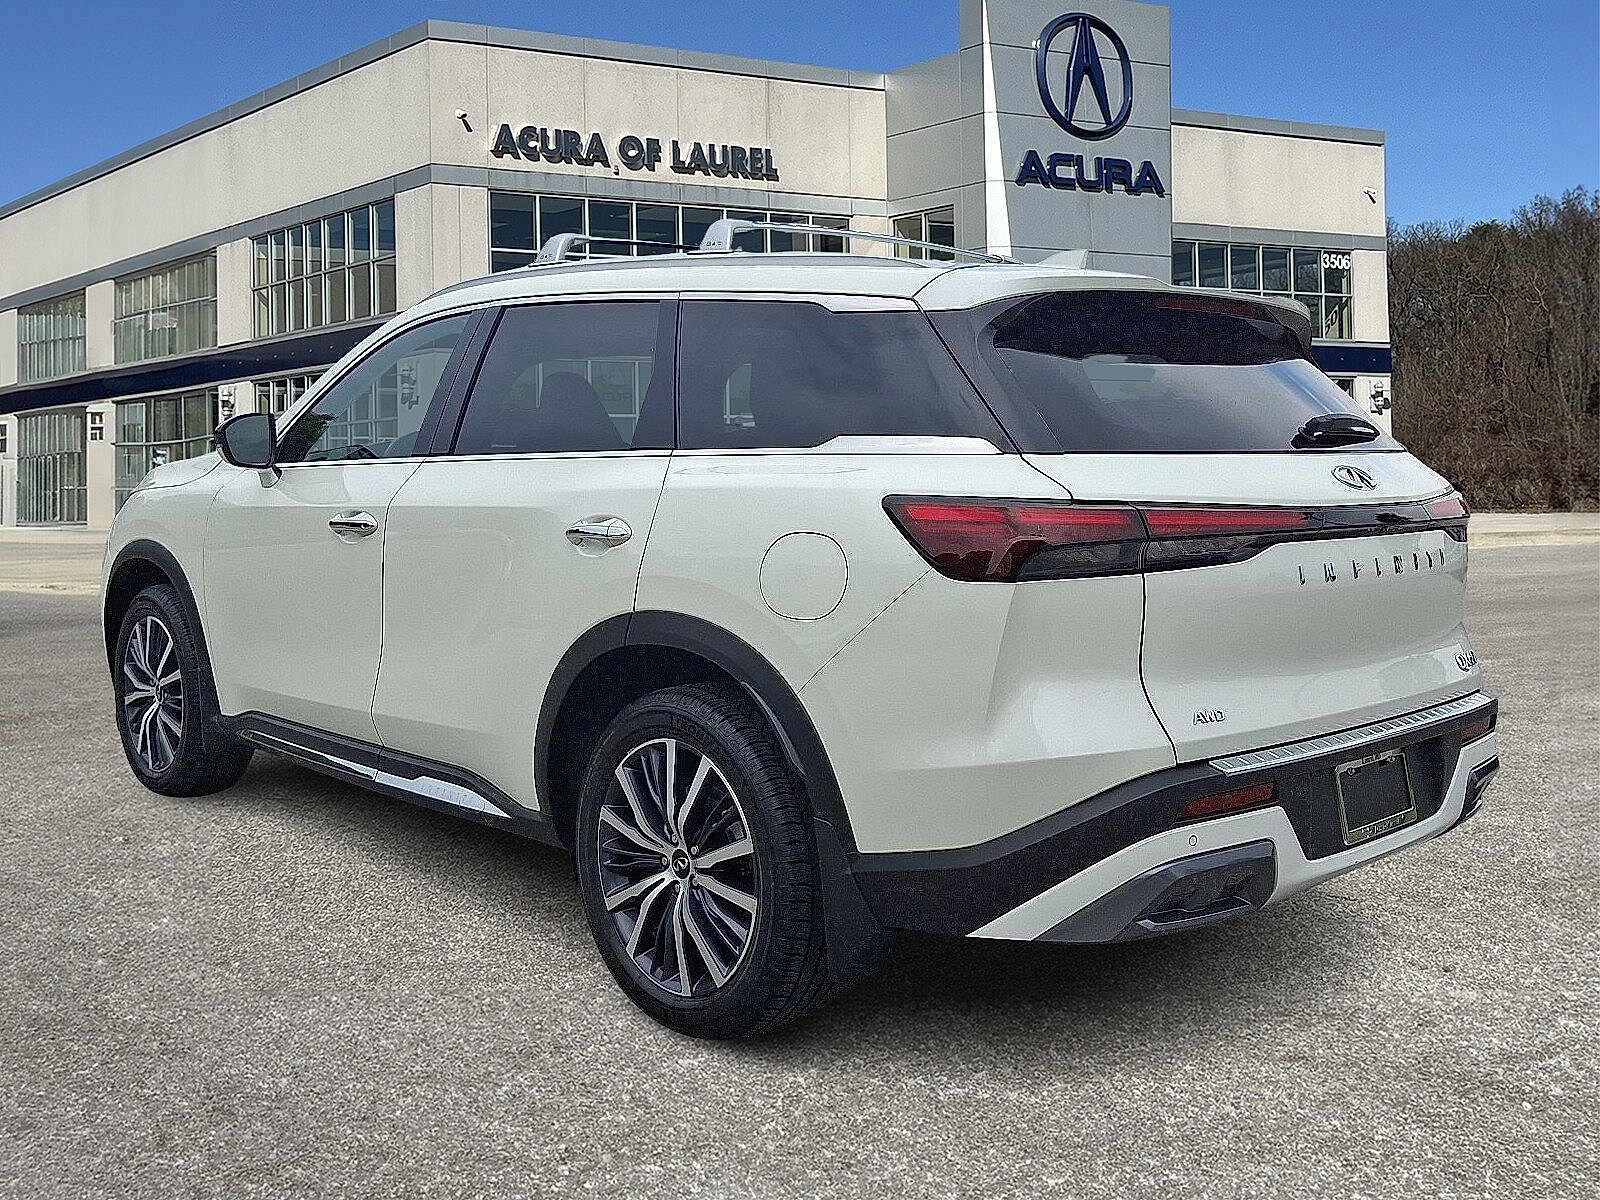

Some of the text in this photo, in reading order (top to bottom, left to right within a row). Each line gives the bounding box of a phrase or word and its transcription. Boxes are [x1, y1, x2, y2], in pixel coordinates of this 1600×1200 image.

[491, 123, 779, 181] ACURA OF LAUREL
[1015, 149, 1166, 198] ACURA
[1322, 253, 1351, 270] 3506
[1192, 709, 1226, 726] AWD
